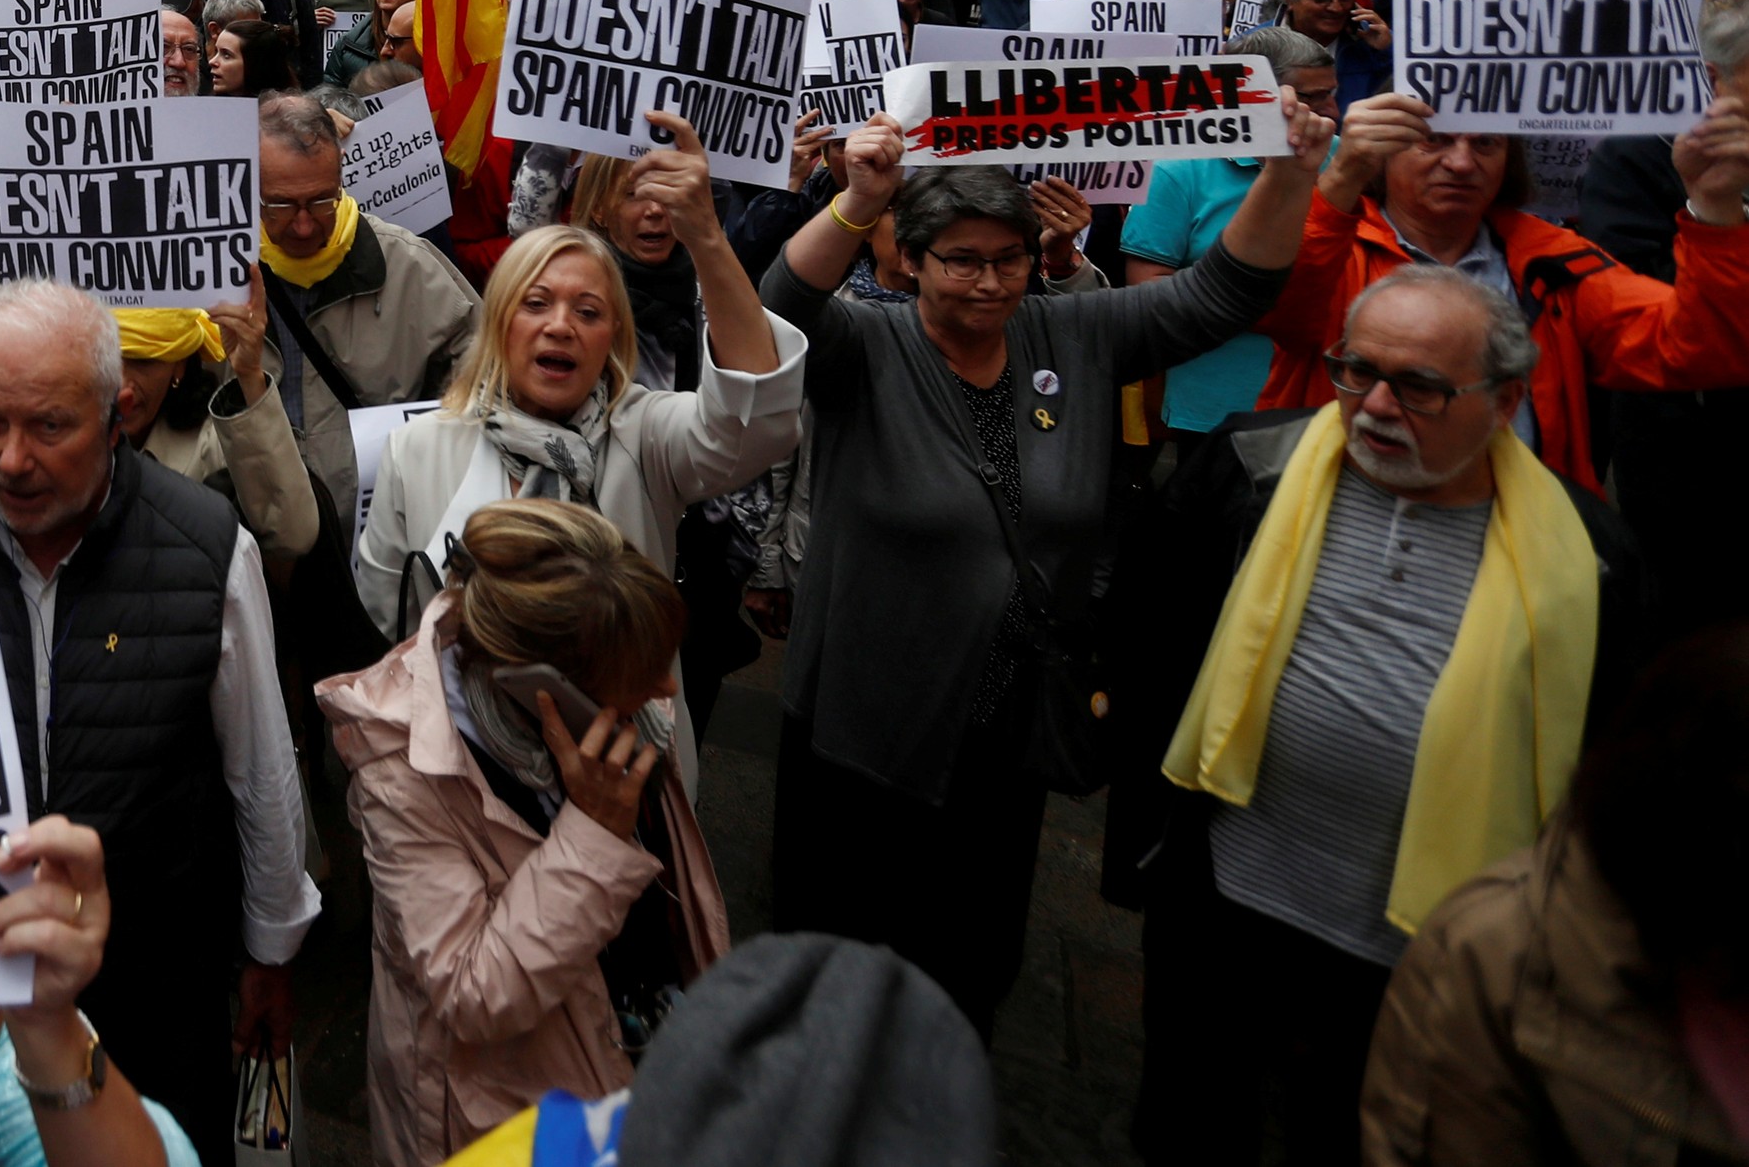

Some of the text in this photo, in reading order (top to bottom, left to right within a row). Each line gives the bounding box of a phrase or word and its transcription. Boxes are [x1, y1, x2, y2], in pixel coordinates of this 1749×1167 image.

[1091, 0, 1166, 32] SPAIN
[90, 13, 157, 71] TALK
[728, 3, 803, 91] TALK
[827, 35, 897, 83] TALK
[507, 50, 790, 164] SPAIN CONVICTS
[801, 85, 887, 127] ONVICT
[930, 63, 1247, 117] LLIBERTAT
[1406, 61, 1526, 114] SPAIN
[25, 106, 154, 166] SPAIN
[368, 131, 393, 158] up
[932, 122, 1069, 151] PRESOS
[1518, 119, 1614, 131] ENCARTELLEM.CAT
[1557, 139, 1586, 153] up
[366, 130, 433, 179] rights
[134, 162, 248, 232] TALK
[68, 232, 251, 291] CONVICTS
